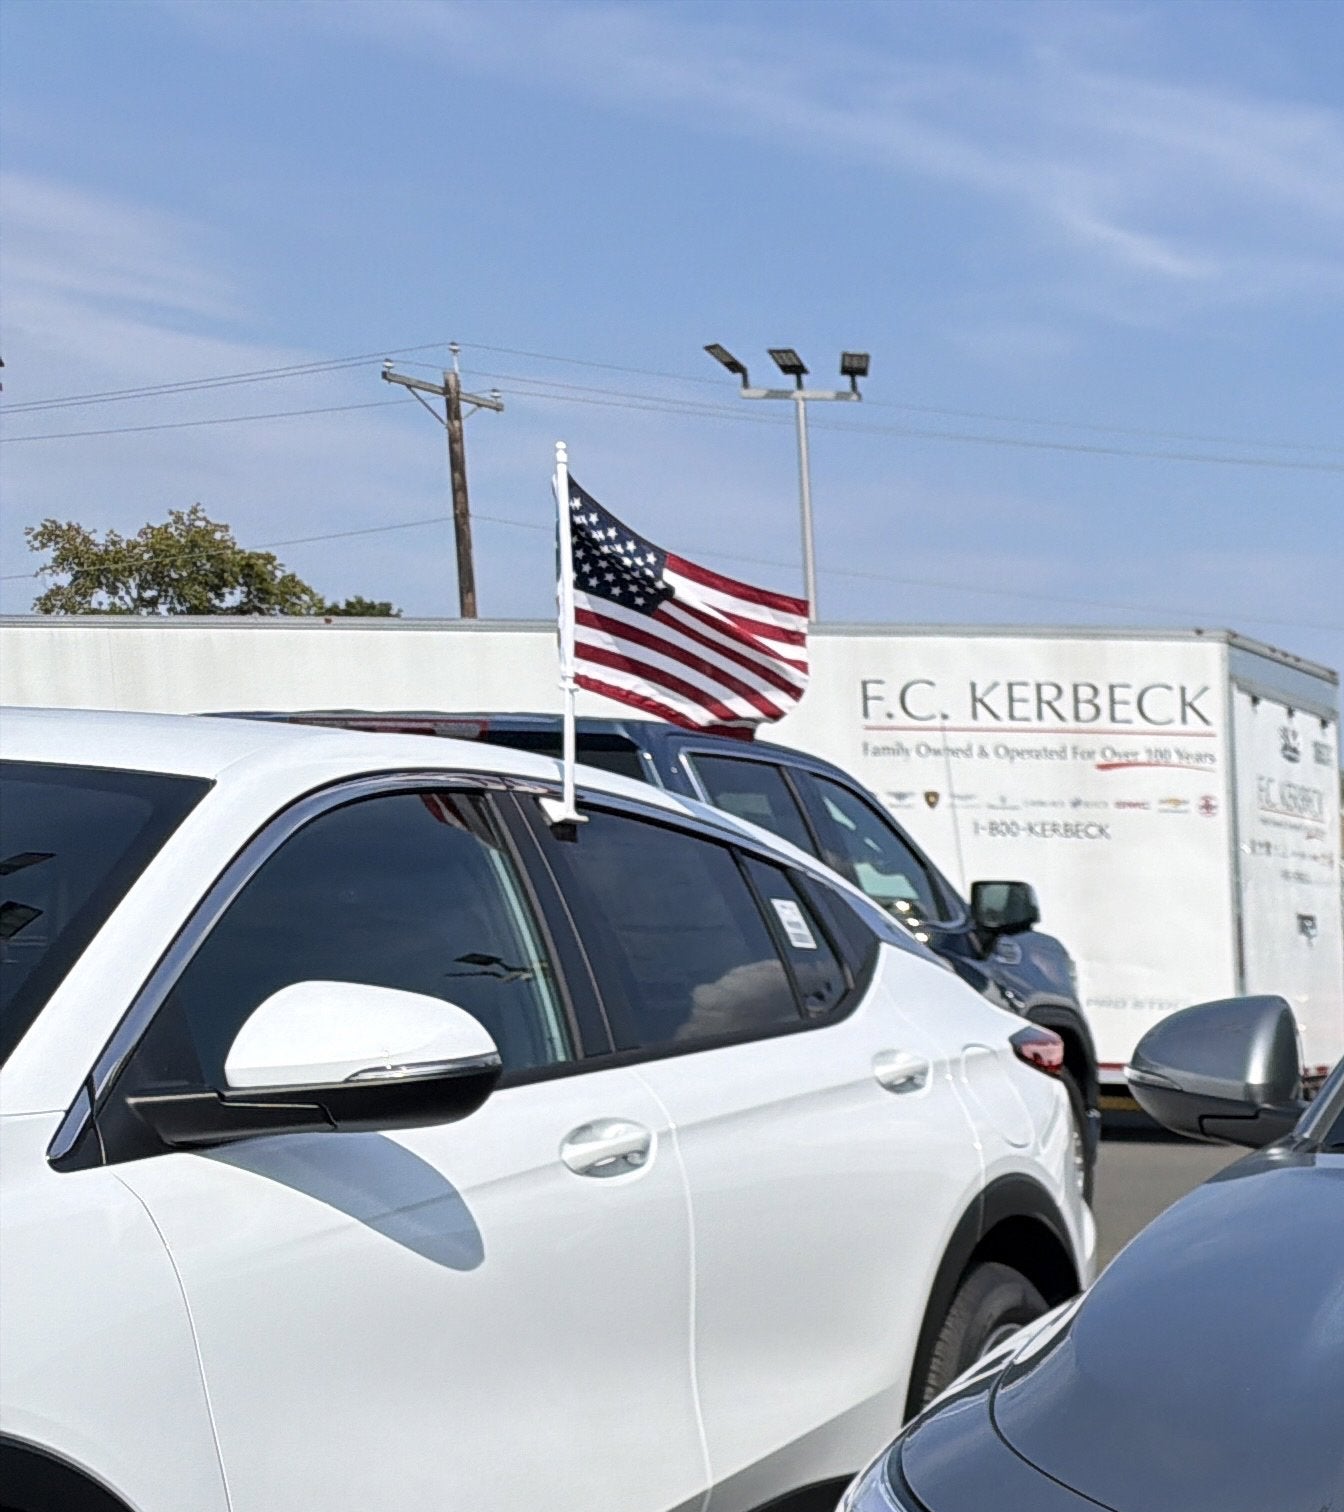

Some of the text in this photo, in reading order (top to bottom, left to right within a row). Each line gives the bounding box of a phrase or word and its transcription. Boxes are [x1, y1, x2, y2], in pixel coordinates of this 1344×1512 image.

[860, 678, 1213, 726] F.C. KERBECK
[862, 742, 1217, 766] Family Owned & Operated For Over 100 Years
[973, 821, 1111, 840] 1-800-KERBECK
